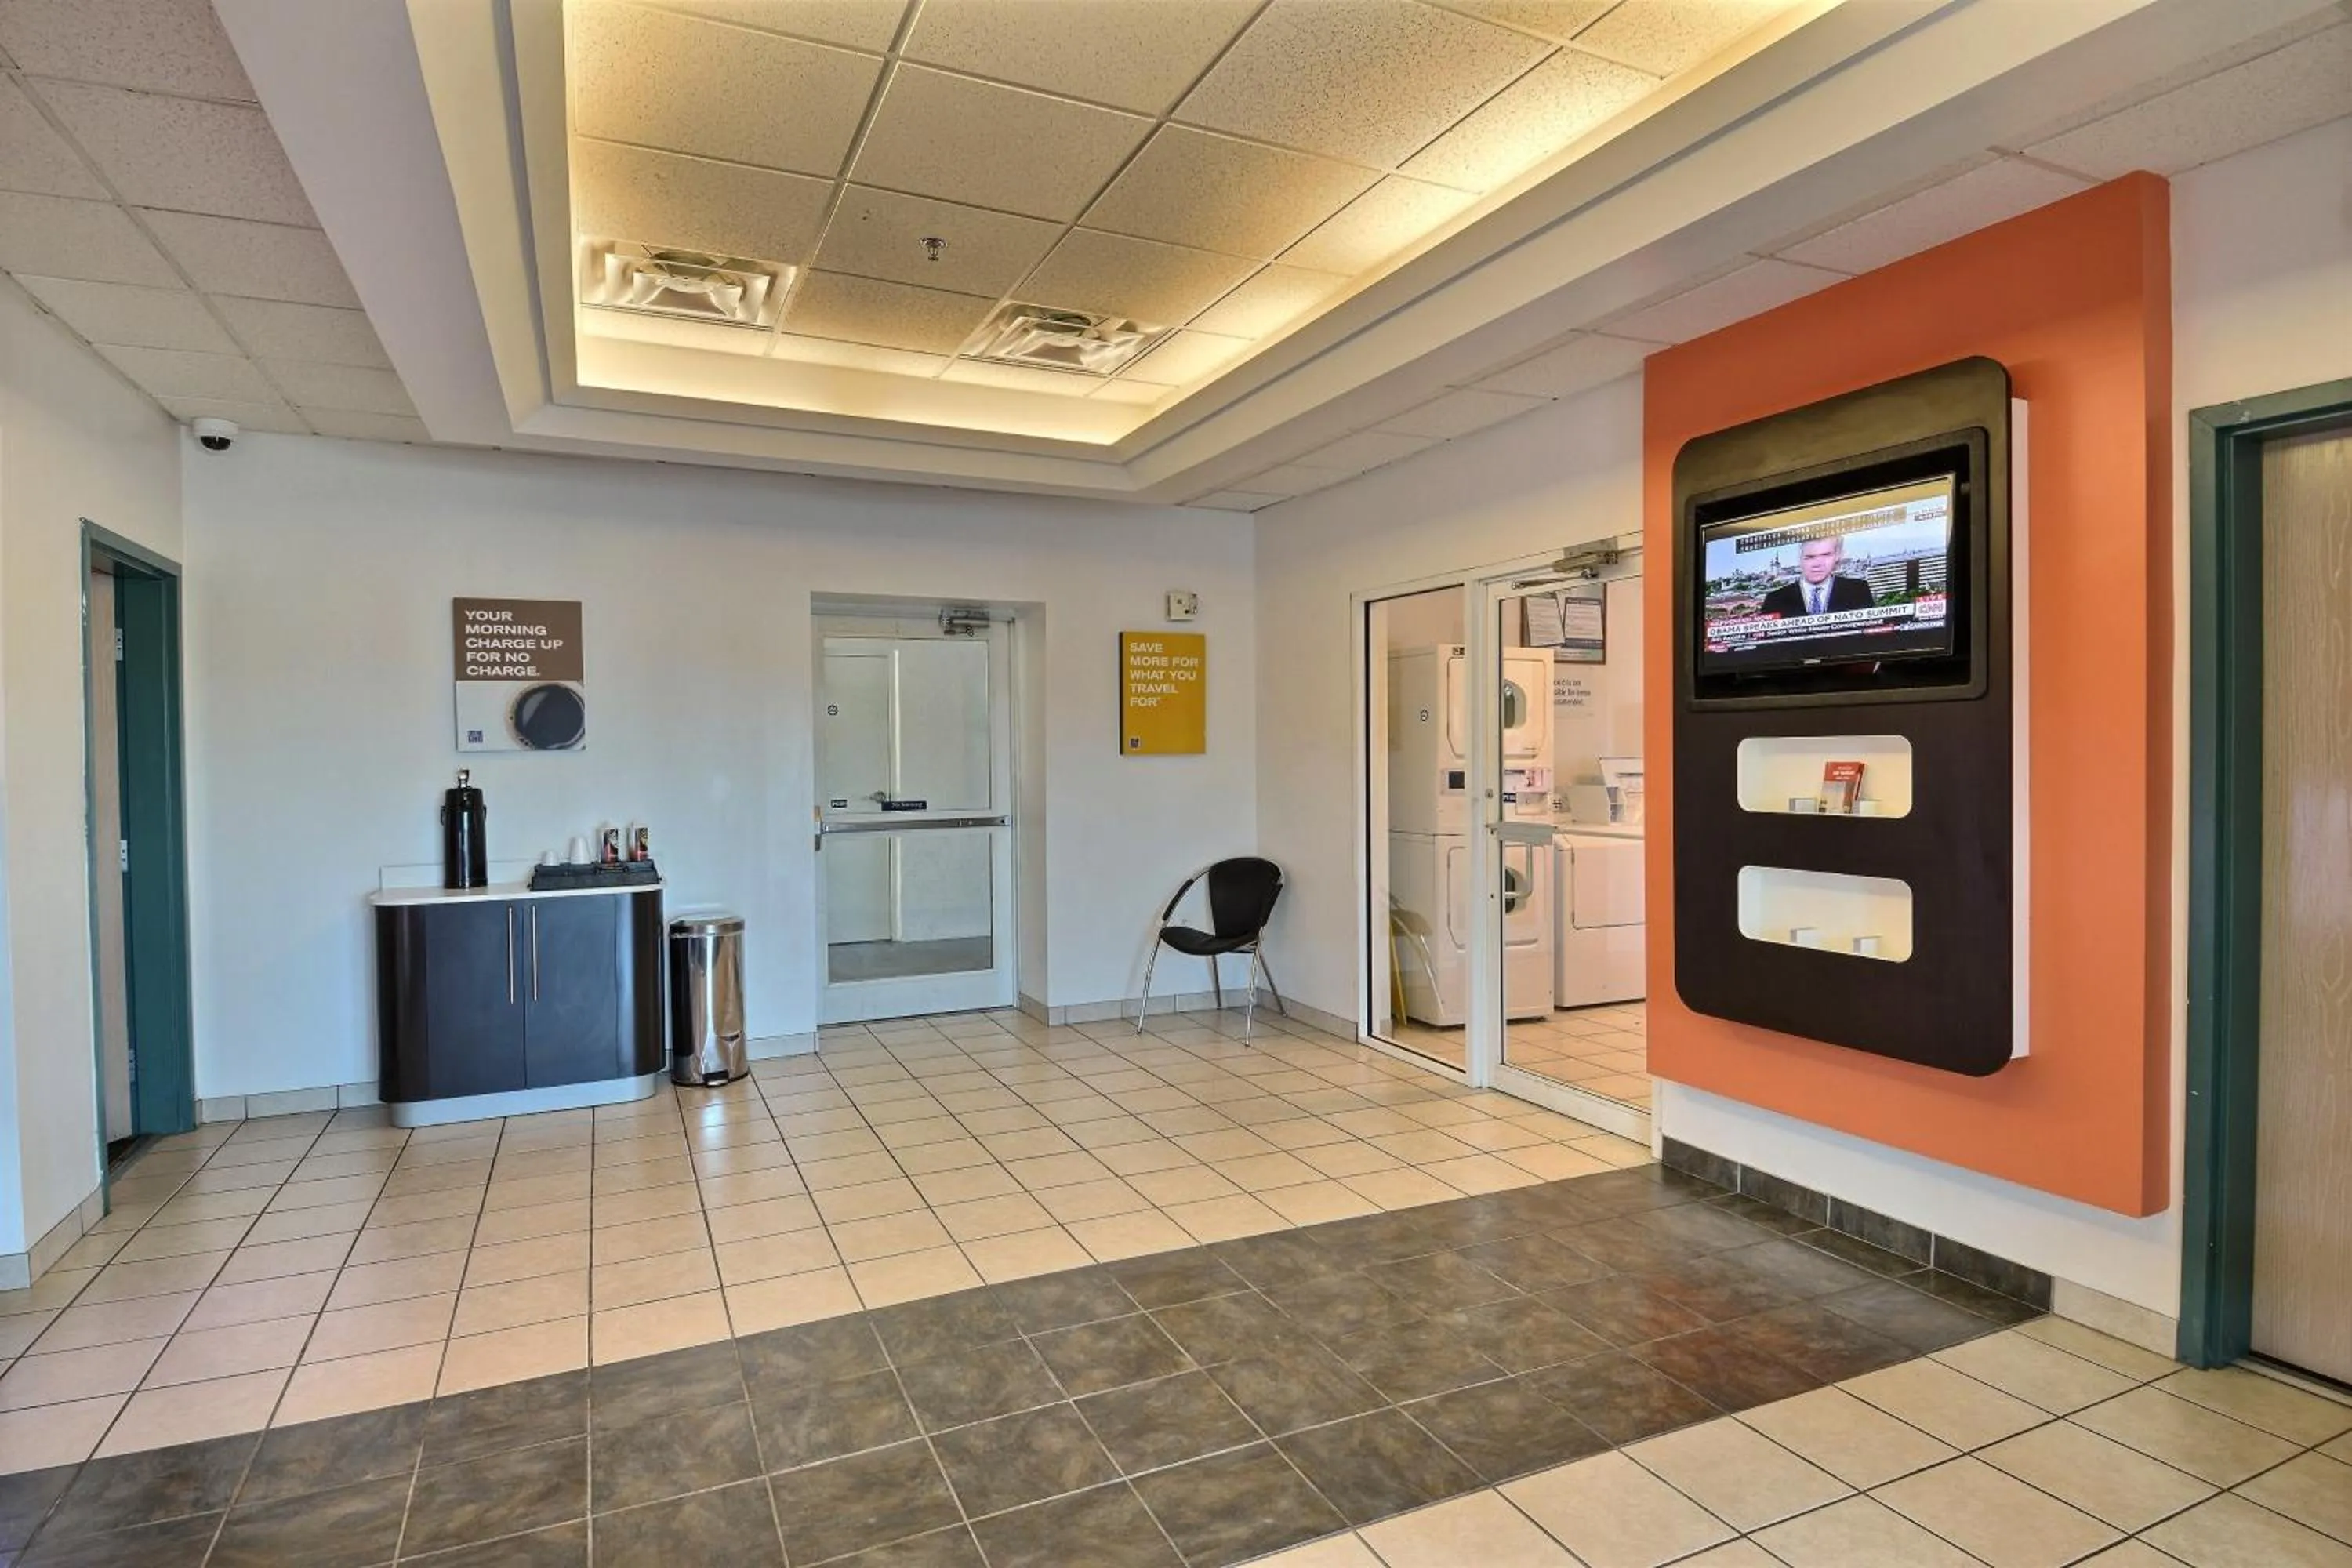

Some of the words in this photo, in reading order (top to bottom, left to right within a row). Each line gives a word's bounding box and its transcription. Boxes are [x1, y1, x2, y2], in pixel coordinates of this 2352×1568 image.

[464, 610, 514, 621] YOUR
[1710, 626, 1742, 636] OBAMA
[1744, 620, 1779, 631] SPEAKS
[1780, 615, 1816, 627] AHEAD
[1817, 614, 1831, 622] OF
[1834, 609, 1864, 621] NATO
[1867, 605, 1907, 617] SUMMIT
[465, 623, 547, 636] MORNING
[465, 637, 537, 649] CHARGE
[539, 639, 564, 650] UP
[1129, 642, 1163, 653] SAVE
[466, 652, 502, 662] FOR
[505, 652, 531, 662] NO
[1130, 655, 1169, 666] MORE
[1171, 656, 1200, 667] FOR
[466, 665, 541, 677] CHARGE.
[1129, 670, 1166, 681] WHAT
[1169, 670, 1196, 681] YOU
[1129, 684, 1179, 694] TRAVEL
